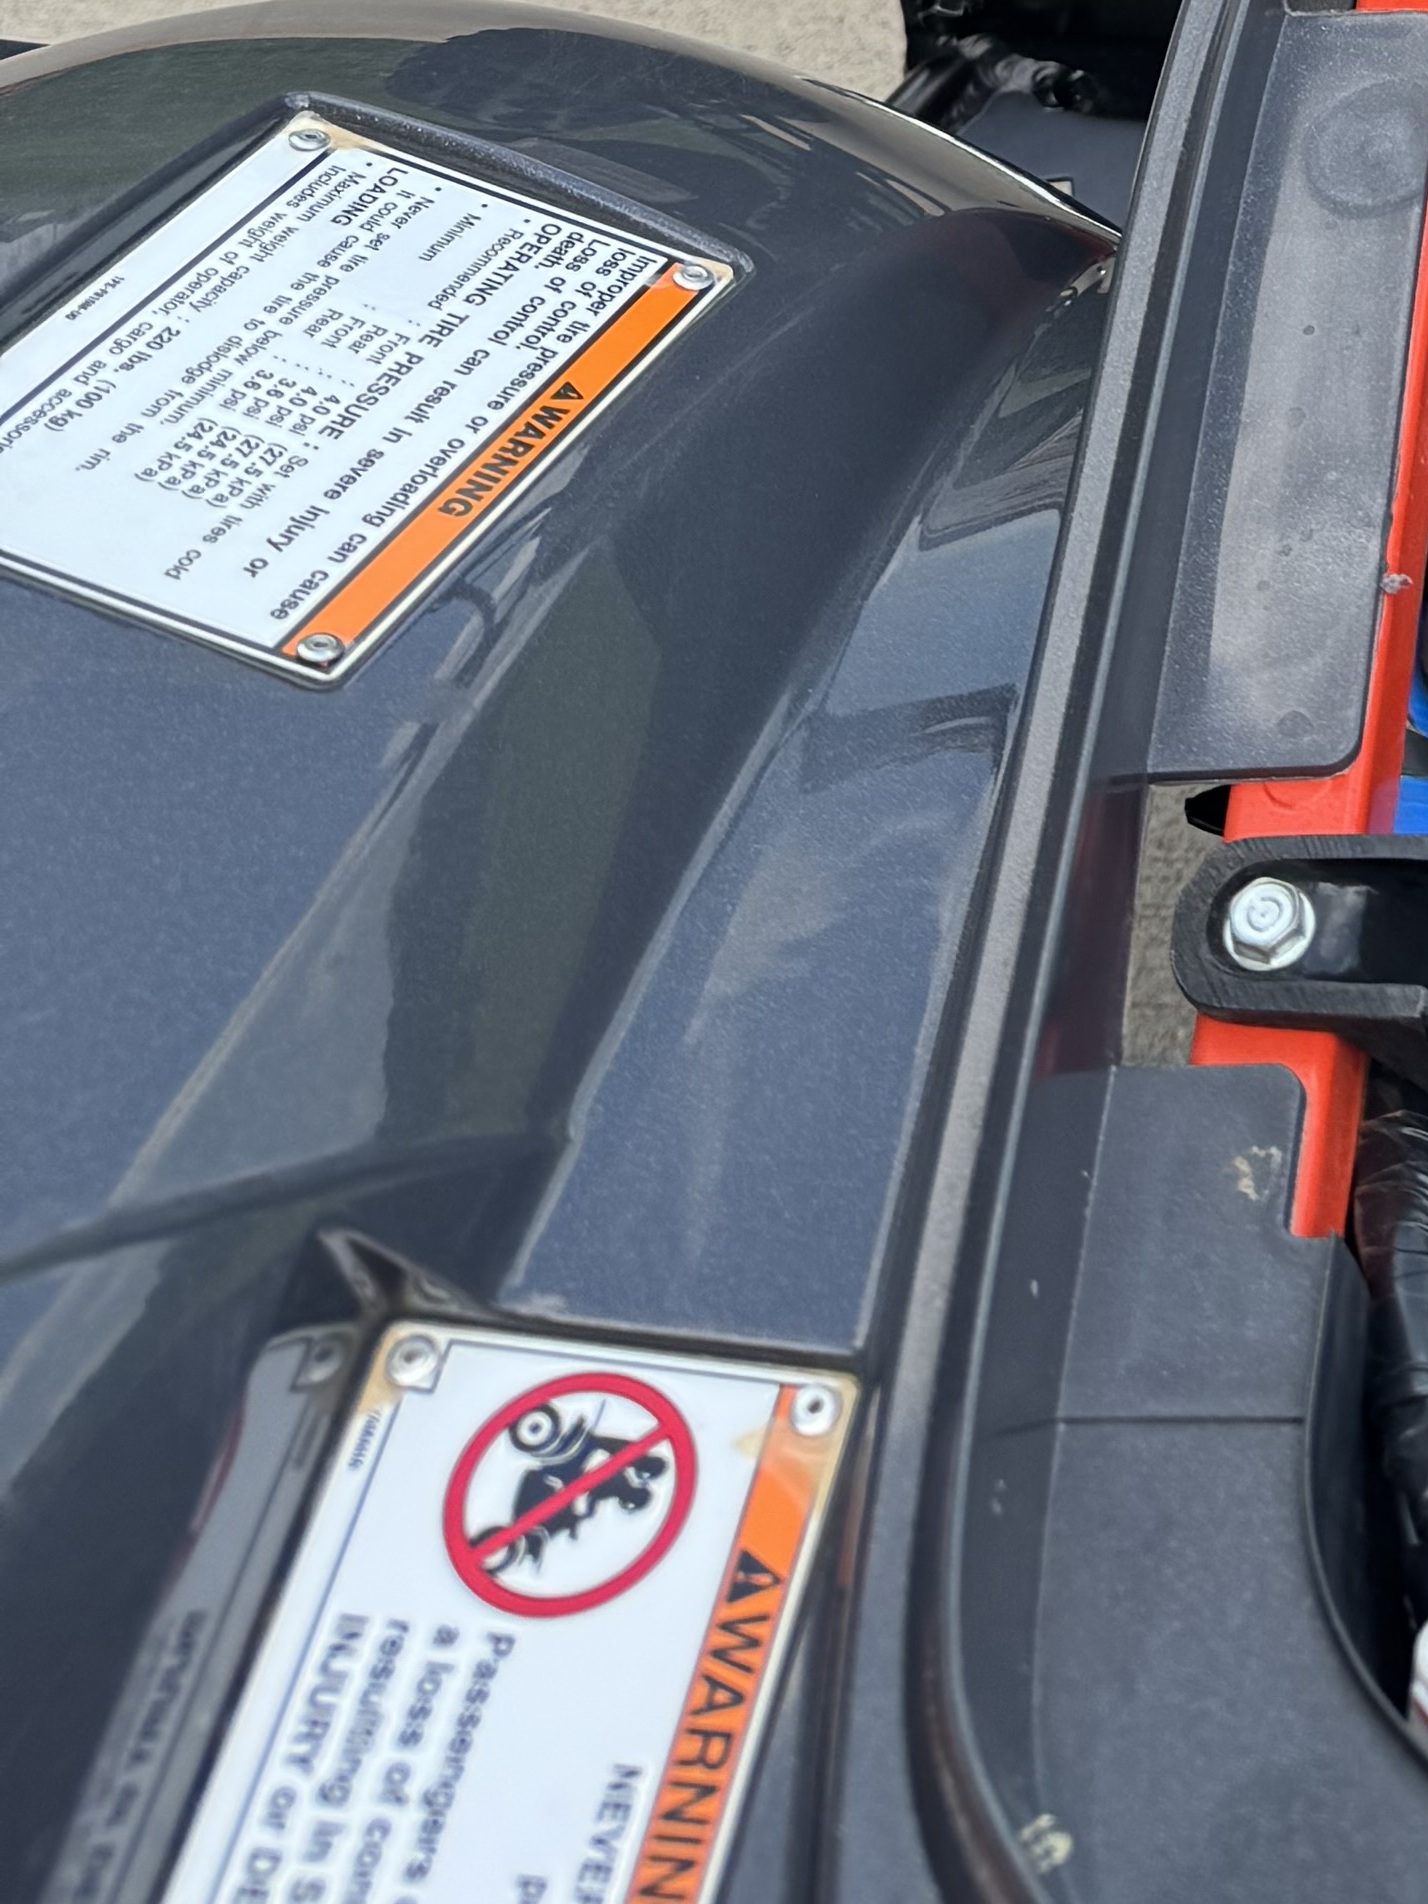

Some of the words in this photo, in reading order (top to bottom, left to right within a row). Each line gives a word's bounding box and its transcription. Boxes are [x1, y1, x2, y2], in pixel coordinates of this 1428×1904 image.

[330, 167, 408, 226] LOADING
[418, 213, 482, 262] Minimum
[534, 232, 584, 269] death.
[427, 228, 525, 311] Recommended
[463, 223, 562, 306] OPERATING
[565, 239, 611, 272] Loss
[595, 248, 636, 277] loss
[544, 276, 566, 294] of
[575, 281, 599, 298] of
[585, 255, 658, 317] Improper
[303, 308, 344, 338] Rear
[321, 316, 366, 349] Front
[418, 313, 470, 348] TIRE
[487, 296, 546, 346] control
[515, 300, 577, 350] control.
[556, 320, 591, 343] tire
[347, 324, 388, 354] Rear
[366, 332, 411, 365] Front
[454, 349, 490, 376] can
[487, 346, 559, 410] pressure
[243, 369, 274, 391] 3.6
[266, 378, 297, 399] 3.6
[318, 351, 424, 440] PRESSURE
[219, 388, 247, 411] psi
[242, 397, 270, 420] psi
[288, 386, 318, 407] 4.0
[312, 394, 341, 415] 4.0
[404, 380, 457, 423] result
[265, 405, 293, 428] psi
[288, 413, 316, 436] psi
[465, 416, 489, 434] or
[173, 417, 218, 452] (24.5
[197, 426, 242, 461] (24.5
[382, 427, 412, 443] in
[134, 451, 181, 482] kPa)
[220, 434, 265, 469] (27.5
[244, 443, 288, 478] (27.5
[274, 455, 309, 478] Set
[438, 405, 570, 517] WARNING
[158, 460, 205, 491] kPa)
[181, 468, 228, 499] kPa)
[323, 449, 385, 500] severe
[362, 438, 465, 527] overloading
[205, 477, 252, 508] kPa)
[240, 484, 275, 509] with
[202, 515, 243, 543] tires
[266, 505, 330, 552] injury
[327, 533, 367, 563] can
[164, 550, 201, 580] cold
[243, 558, 269, 578] or
[270, 570, 329, 620] cause
[433, 1624, 460, 1648] a
[280, 1613, 370, 1775] INJURY
[398, 1660, 455, 1749] loss
[380, 1760, 412, 1807] of
[262, 1785, 297, 1830] or
